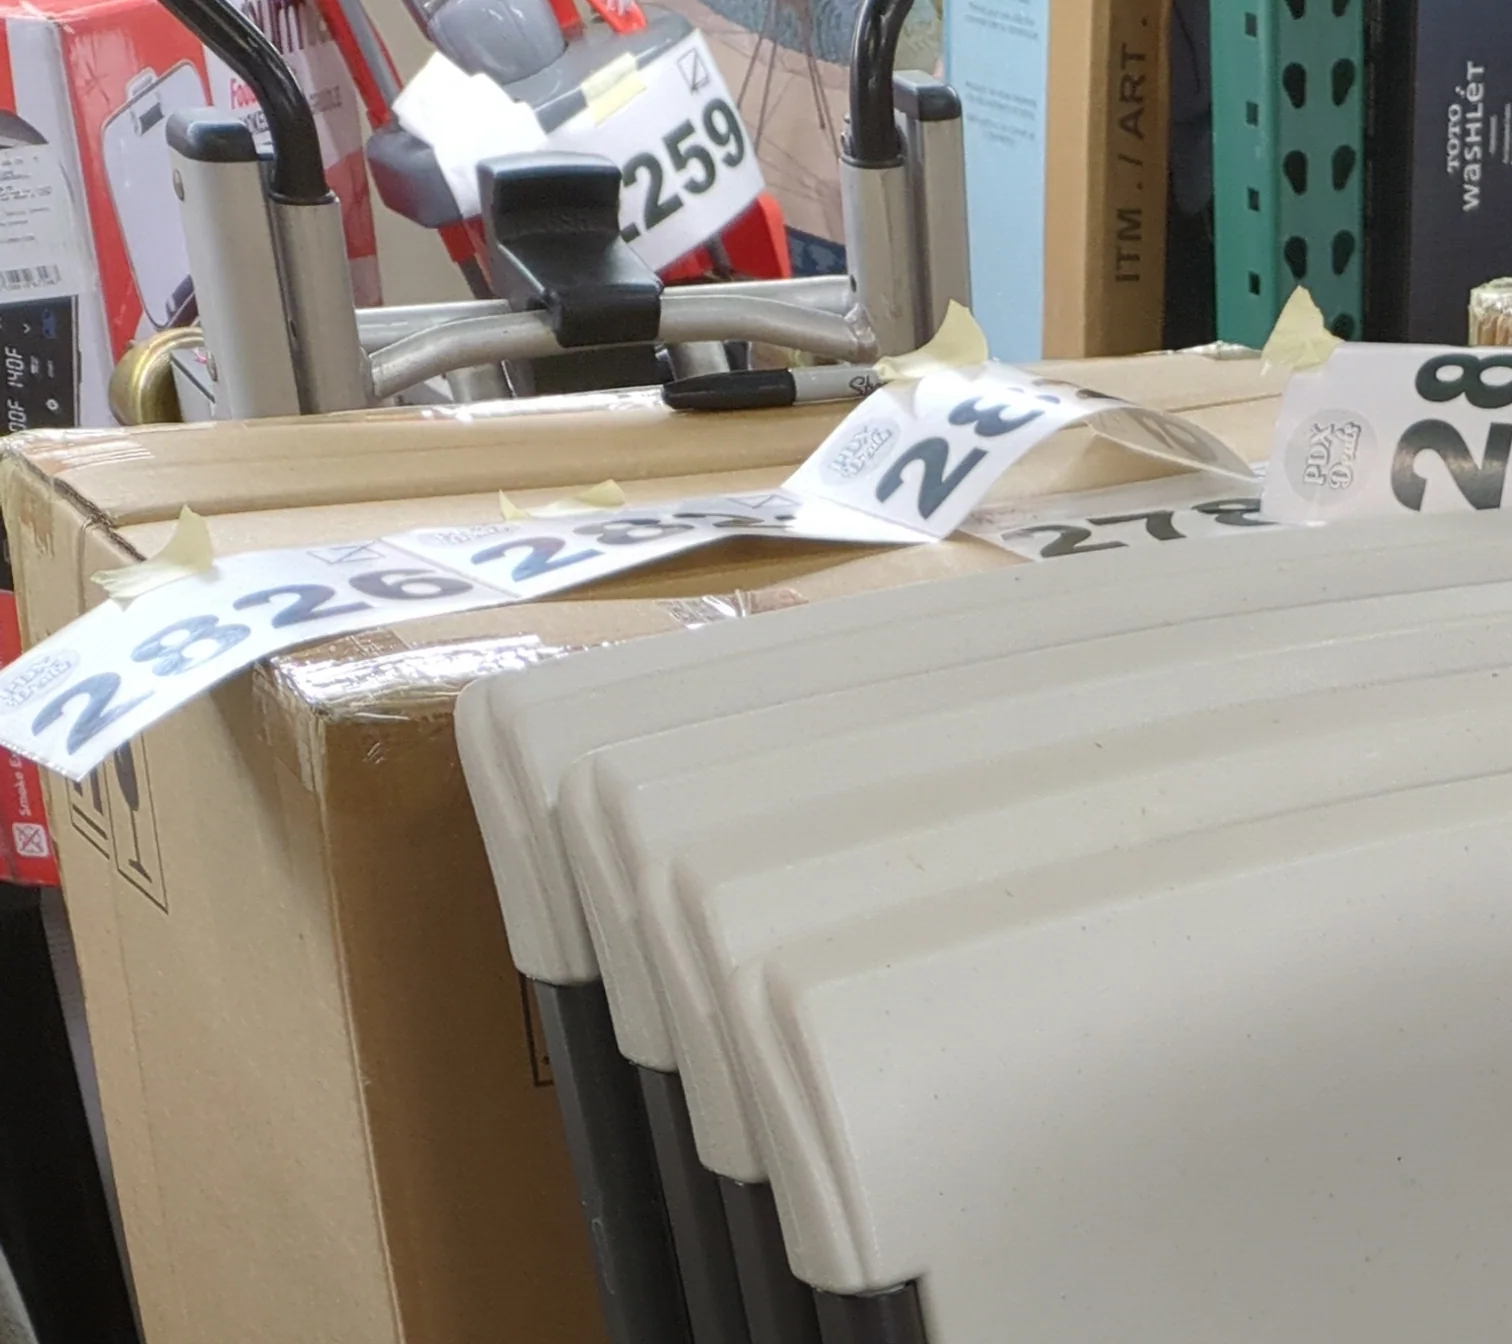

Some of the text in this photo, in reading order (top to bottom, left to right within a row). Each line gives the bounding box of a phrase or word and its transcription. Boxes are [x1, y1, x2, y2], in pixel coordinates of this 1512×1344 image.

[620, 97, 745, 244] 259
[1447, 103, 1463, 174] TOTO
[1115, 182, 1143, 283] ITM.
[31, 567, 474, 756] 2826
